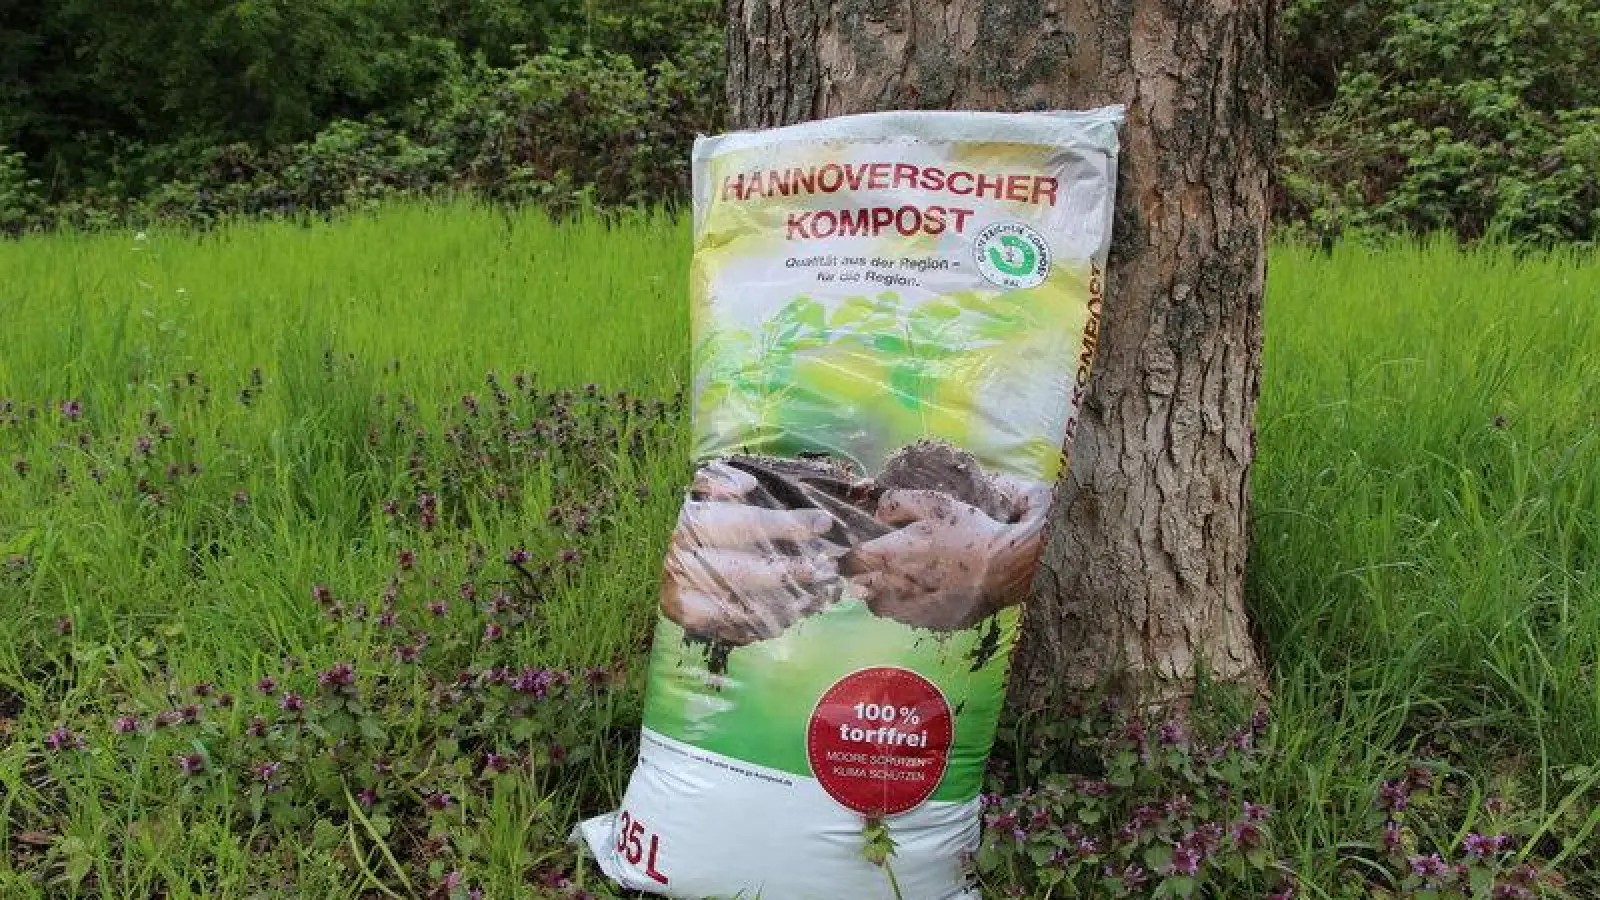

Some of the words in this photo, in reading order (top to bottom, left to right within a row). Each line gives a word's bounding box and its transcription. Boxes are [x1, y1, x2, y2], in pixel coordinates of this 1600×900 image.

[722, 163, 1059, 206] HANNOVERSCHER
[786, 205, 974, 240] KOMPOST
[785, 255, 837, 268] Qualität
[841, 256, 866, 267] aus
[870, 256, 895, 269] der
[900, 257, 949, 272] Region
[816, 271, 836, 282] für
[839, 270, 862, 282] die
[865, 271, 921, 288] Region.
[854, 703, 895, 721] 100
[899, 706, 921, 725] %
[839, 723, 928, 748] torffrei
[827, 751, 869, 762] MOORE
[833, 766, 867, 777] KLIMA
[617, 810, 645, 865] 35
[646, 834, 669, 885] L
